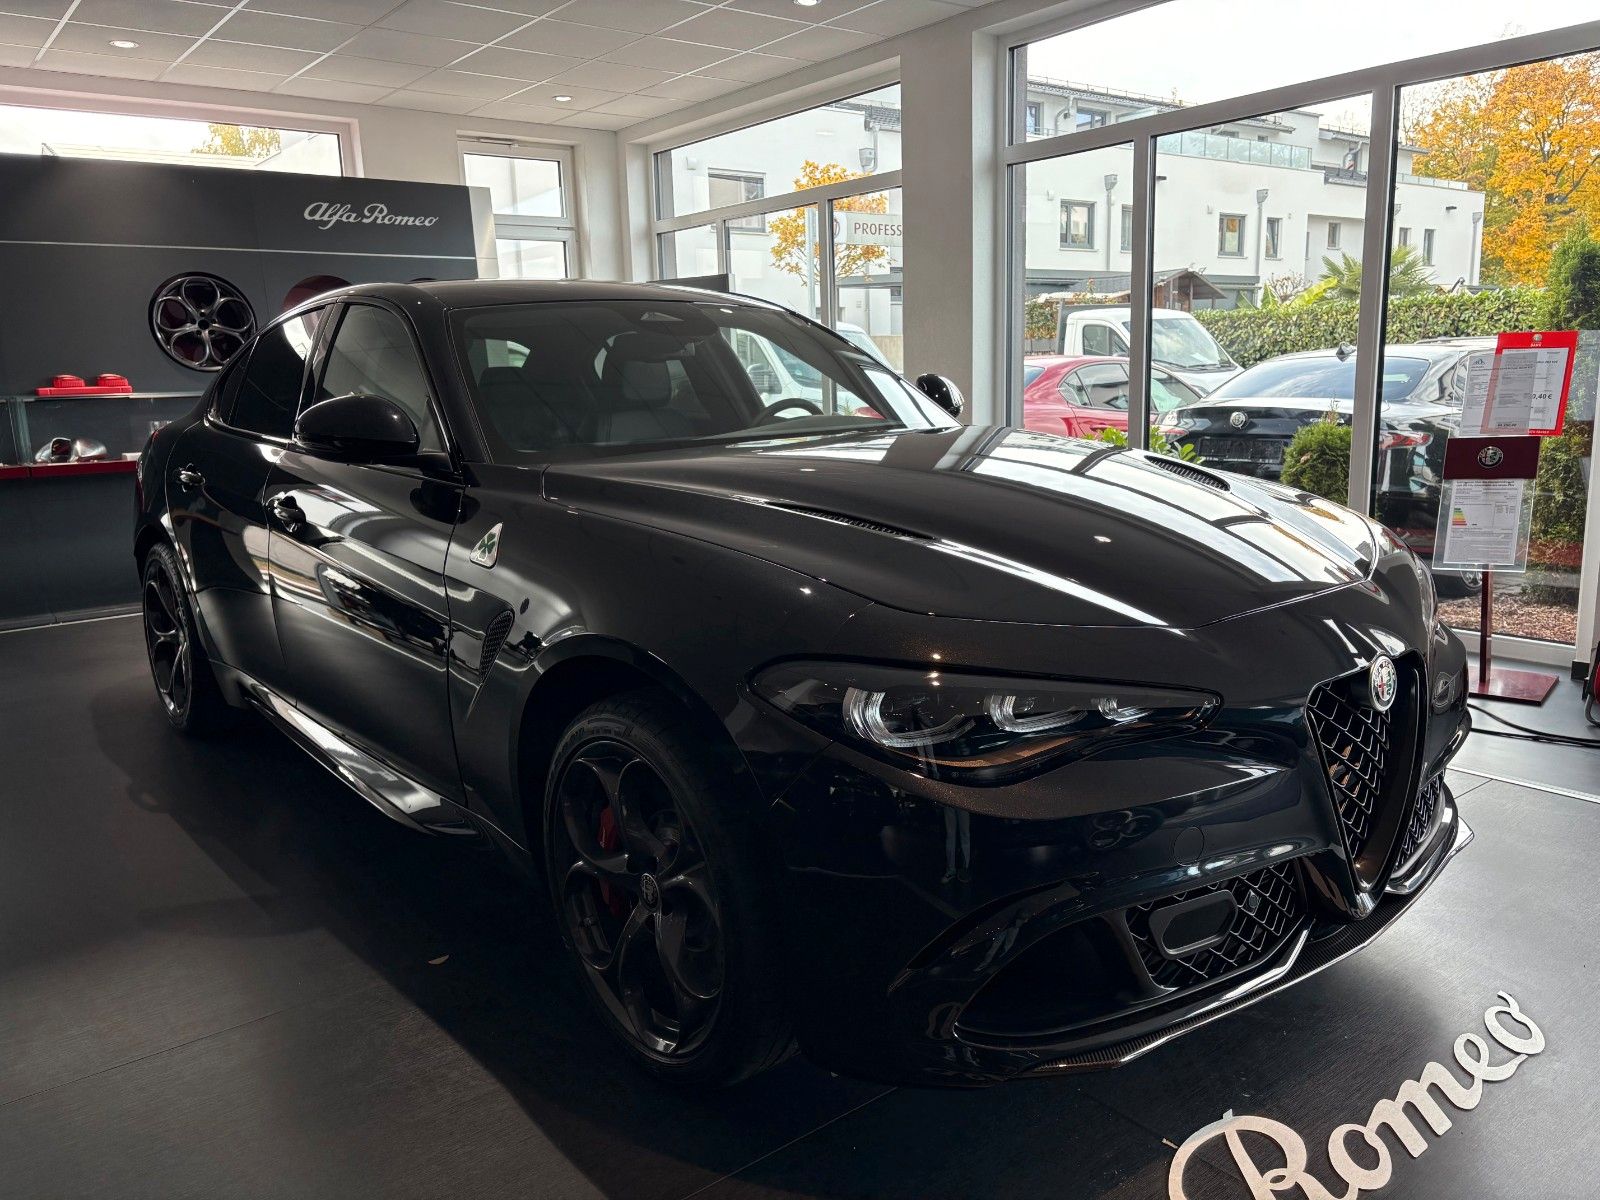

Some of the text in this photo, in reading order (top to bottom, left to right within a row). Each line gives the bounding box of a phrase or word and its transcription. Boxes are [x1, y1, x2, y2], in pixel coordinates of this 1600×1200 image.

[303, 202, 439, 230] Alfa Romeo
[854, 222, 903, 237] PROFESS
[1168, 990, 1546, 1200] Romeo
